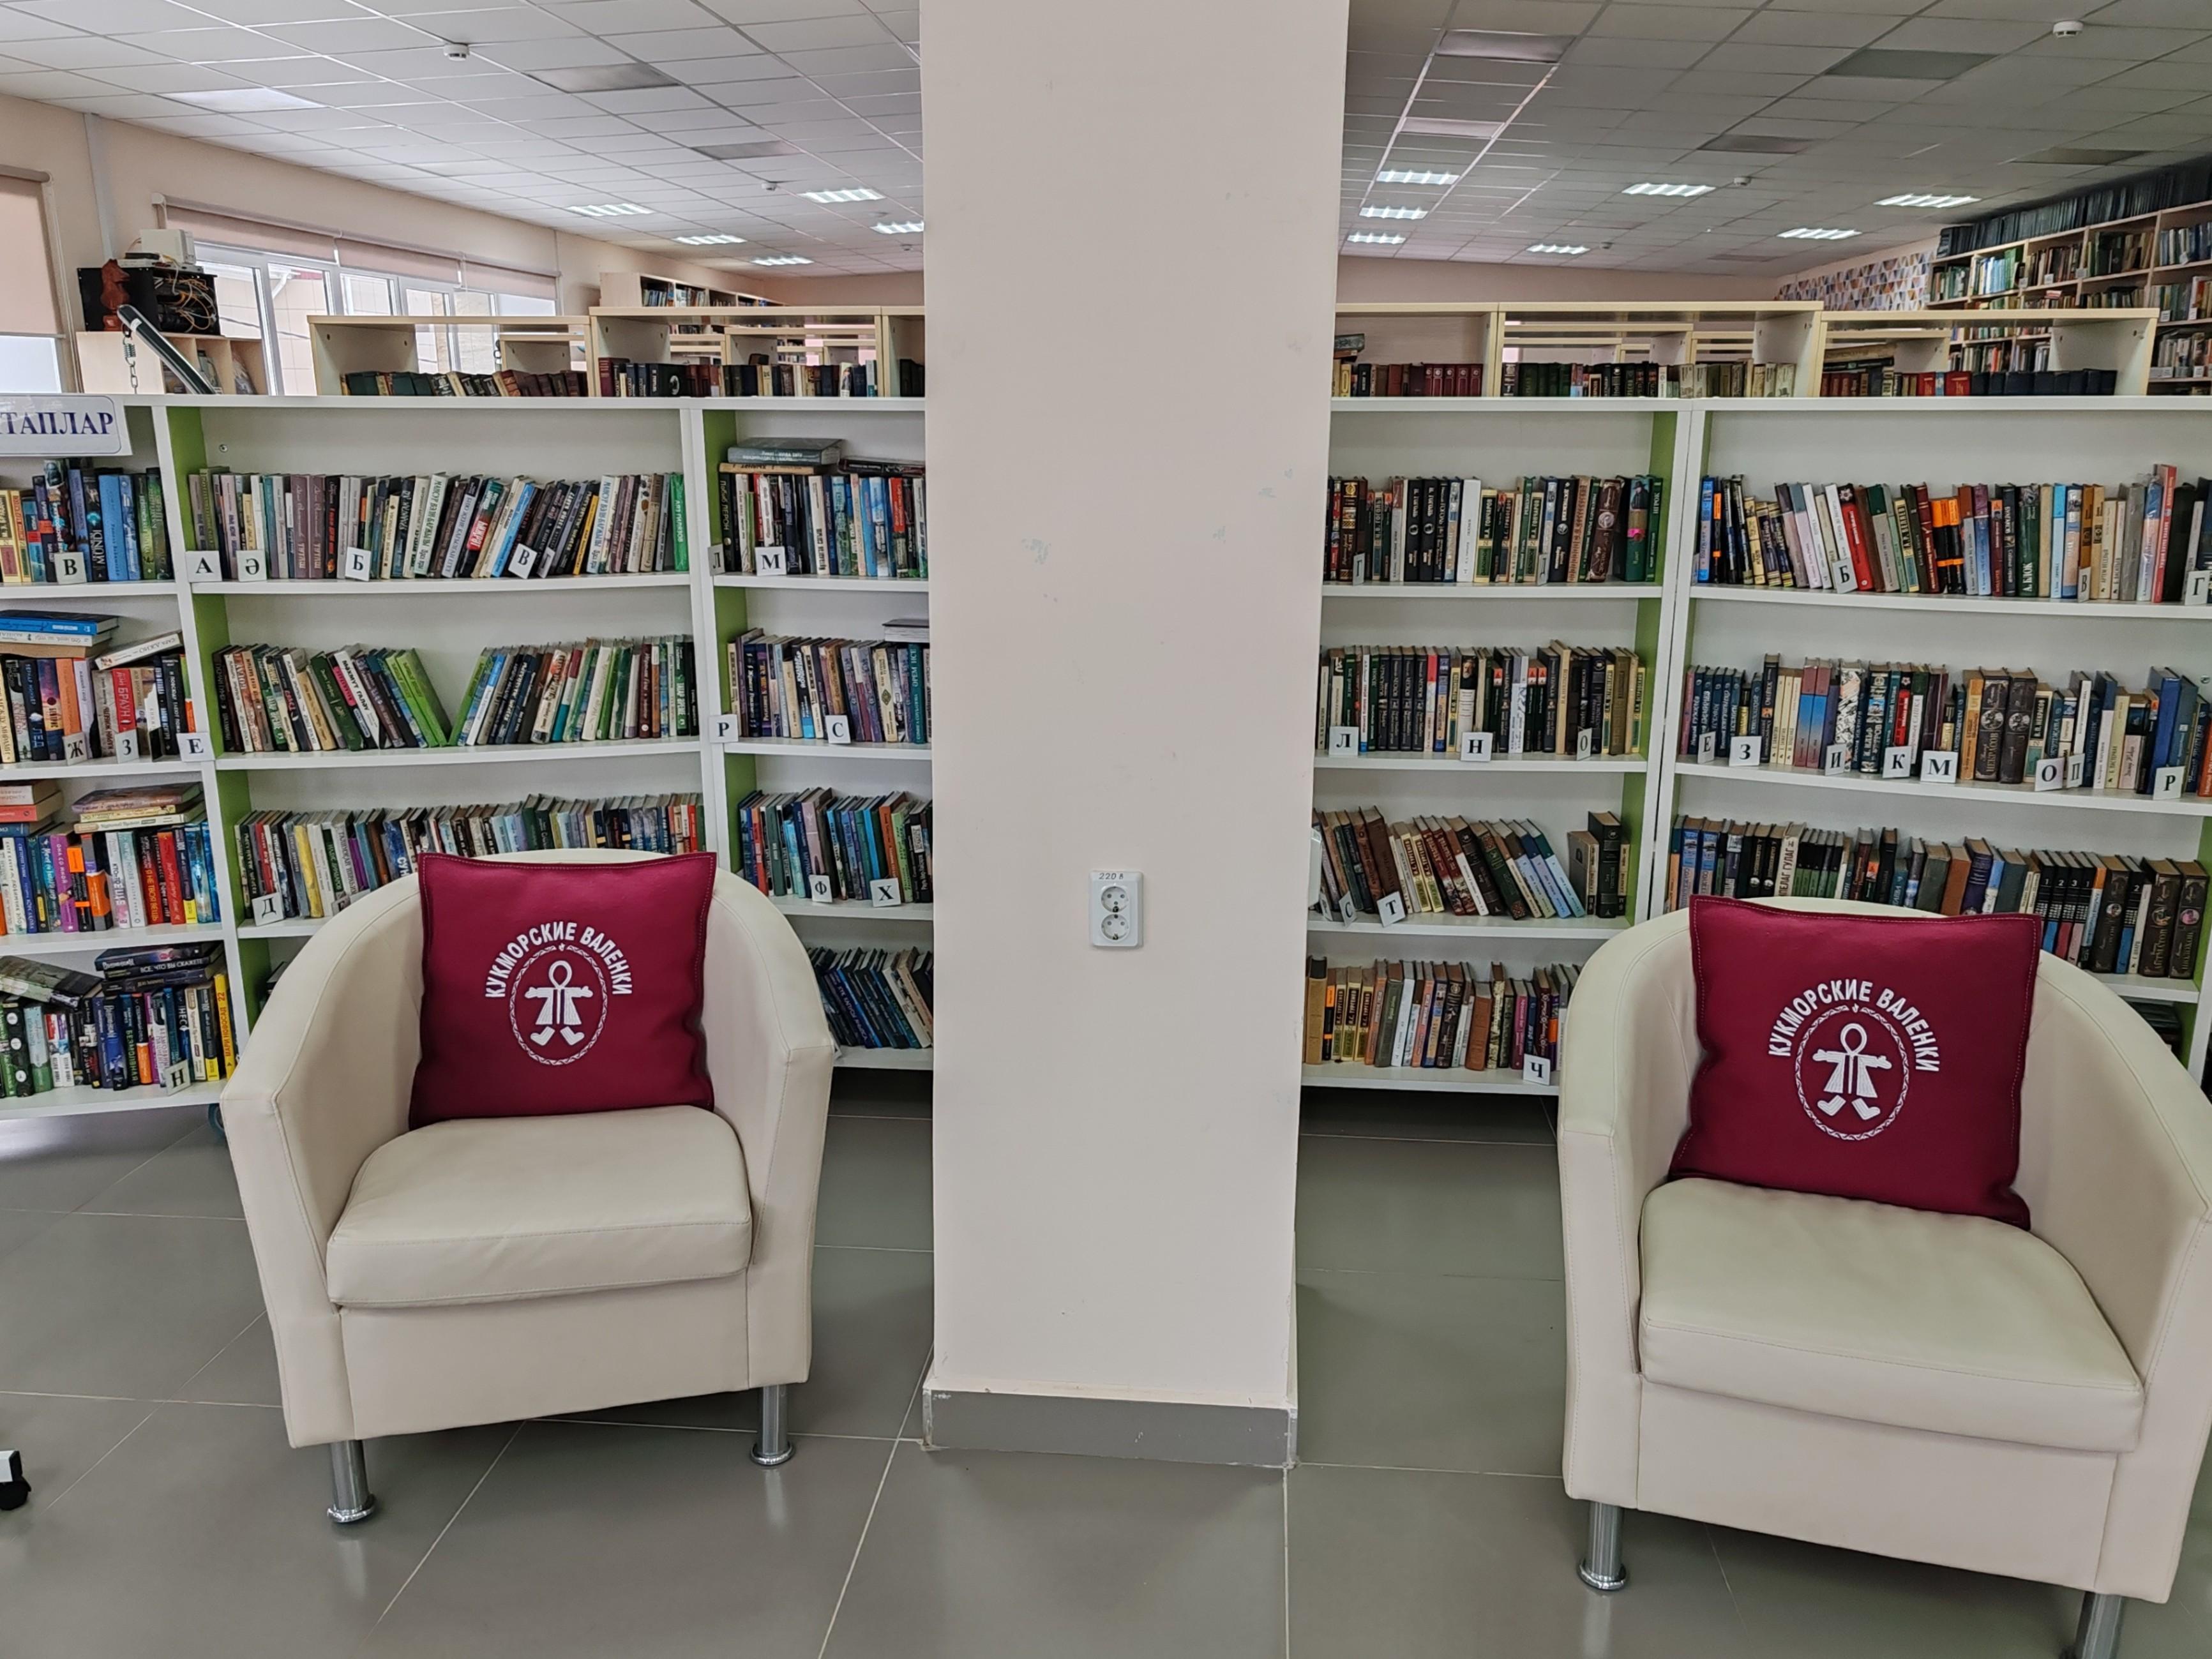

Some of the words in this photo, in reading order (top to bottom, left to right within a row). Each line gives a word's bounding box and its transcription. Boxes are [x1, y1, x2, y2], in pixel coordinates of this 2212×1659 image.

[94, 530, 105, 564] MUNDI
[195, 557, 213, 573] А
[246, 558, 259, 574] Ә
[352, 554, 364, 571] Б
[518, 550, 530, 566] В
[712, 552, 722, 569] Л
[762, 554, 781, 569] М
[63, 559, 77, 576] В
[1839, 564, 1850, 583] Б
[2023, 562, 2033, 582] БЛОК
[2022, 583, 2033, 592] А.
[2081, 575, 2088, 593] В
[2192, 577, 2205, 596] Г
[117, 672, 126, 684] ДЭН
[118, 686, 131, 717] БРАУН
[2035, 700, 2045, 726] НЕКРАСОВ
[33, 728, 45, 748] ЛЕД
[718, 723, 730, 737] Р
[832, 723, 844, 737] С
[122, 739, 132, 755] З
[188, 739, 204, 754] Е
[1336, 733, 1351, 748] Л
[1468, 740, 1483, 754] Н
[1580, 735, 1588, 751] О
[1703, 735, 1711, 753] Е
[68, 740, 84, 759] Ж
[1739, 744, 1751, 760] З
[1986, 732, 1999, 772] НЕКРАСОВ
[1831, 751, 1842, 769] И
[1891, 753, 1906, 770] К
[1928, 759, 1953, 776] М
[2042, 765, 2056, 781] О
[2071, 762, 2080, 781] П
[2163, 774, 2176, 792] Р
[112, 863, 122, 887] КТО-ТО
[815, 881, 827, 895] Ф
[877, 885, 894, 901] Х
[262, 897, 276, 919] Д
[1345, 901, 1353, 918] С
[1385, 900, 1397, 915] Т
[140, 965, 158, 973] ВСЕ,
[176, 958, 203, 968] СКАЖЕТЕ
[485, 921, 577, 998] КУКМОРСКИЕ
[580, 927, 632, 995] ВАЛЕНКИ
[218, 992, 226, 1001] 22
[218, 1007, 230, 1037] НОВОСАД
[1768, 979, 1873, 1056] КУКМОРСКИЕ
[1876, 988, 1940, 1071] ВАЛЕНКИ
[126, 1030, 139, 1081] БЕЗМОЛВНАЯ
[222, 1039, 232, 1057] МАРИ
[171, 1069, 184, 1085] Н
[1530, 1062, 1544, 1079] Ч
